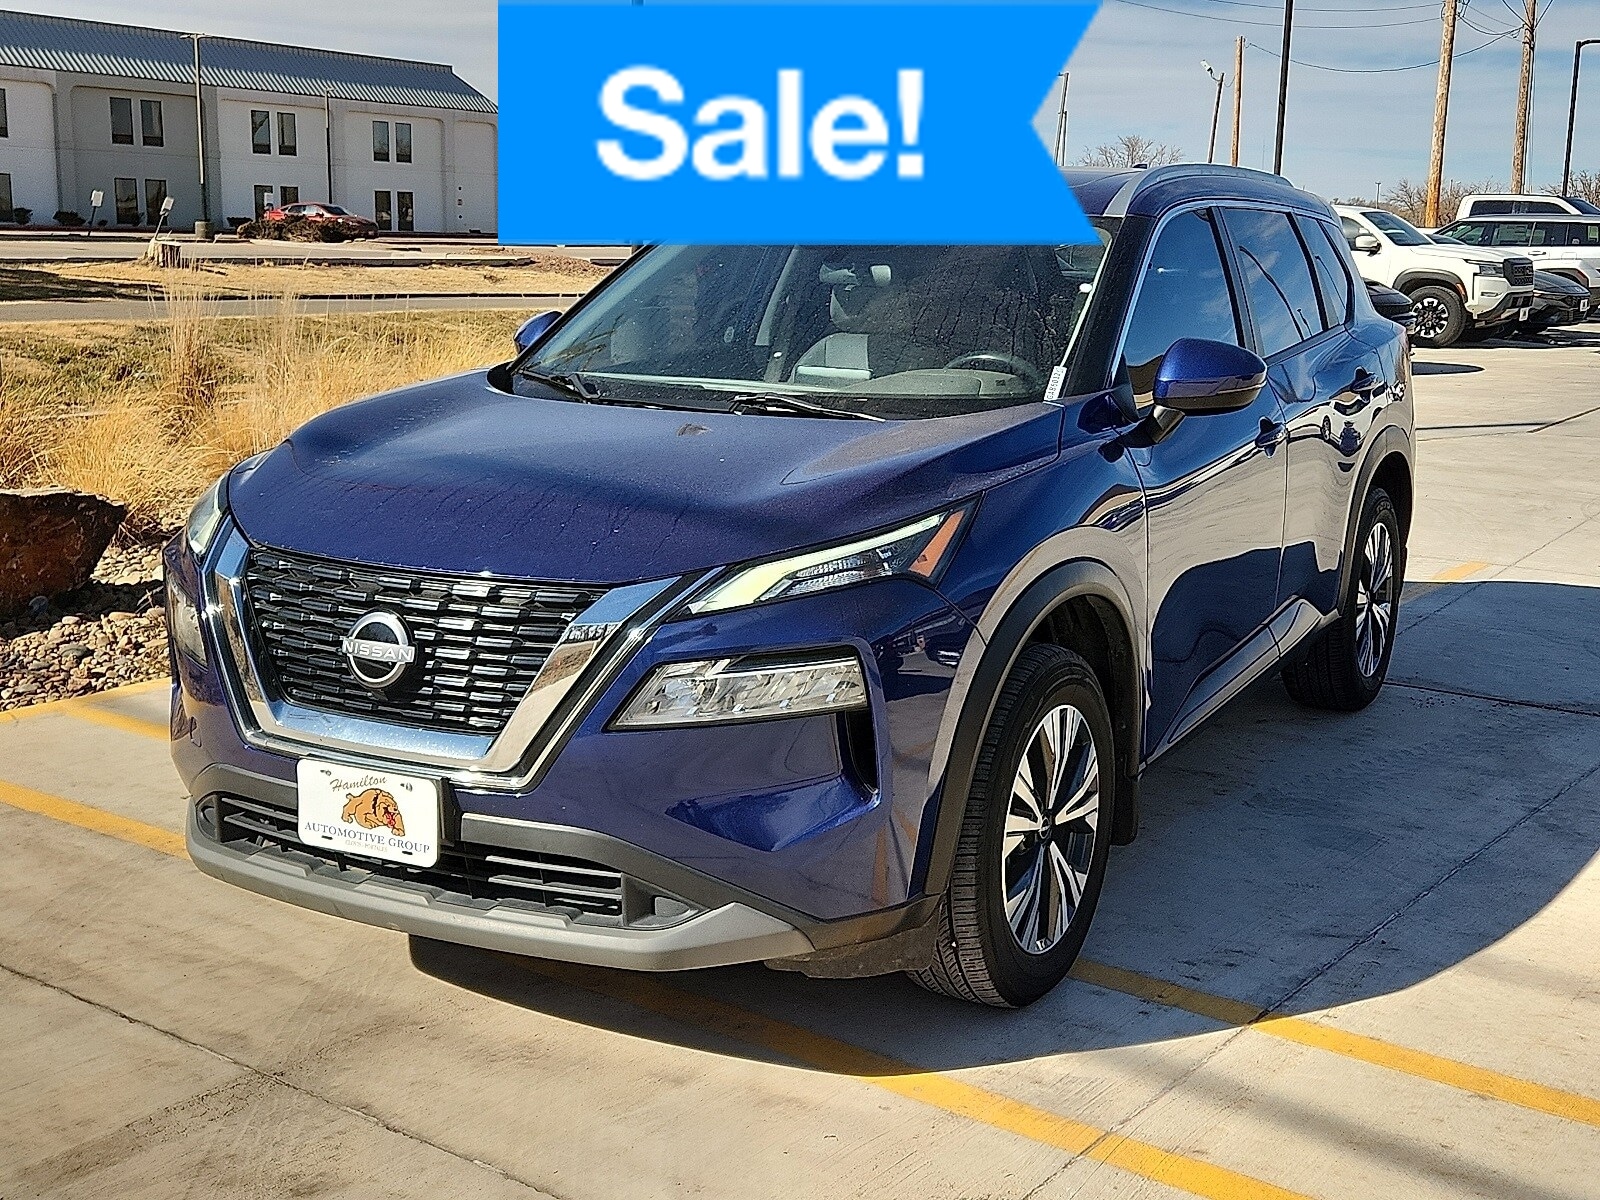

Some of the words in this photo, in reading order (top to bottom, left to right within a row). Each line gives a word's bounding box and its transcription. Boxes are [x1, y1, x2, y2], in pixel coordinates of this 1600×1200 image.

[343, 640, 412, 661] NISSAN
[329, 775, 388, 792] Hamilton
[304, 822, 386, 846] AUTOMOTIVE
[388, 838, 430, 854] GROUP
